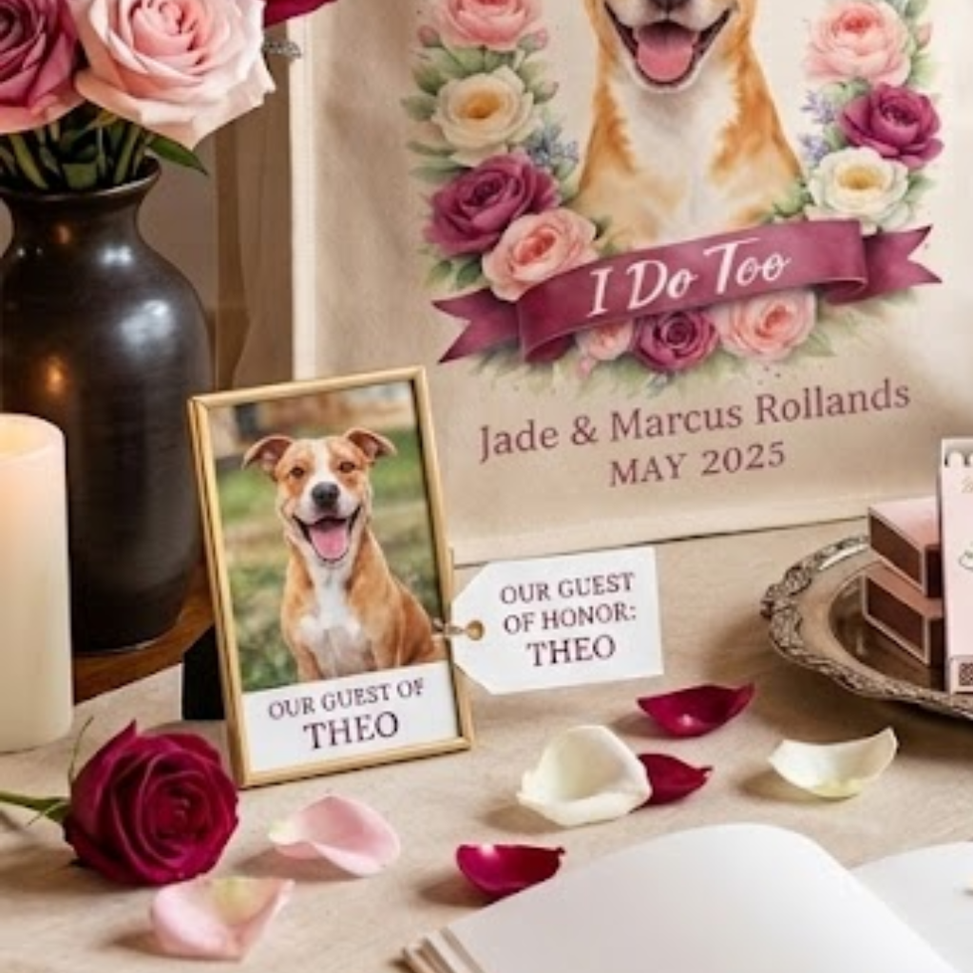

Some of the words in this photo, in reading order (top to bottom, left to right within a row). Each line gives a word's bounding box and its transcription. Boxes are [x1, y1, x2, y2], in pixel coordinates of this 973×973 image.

[586, 265, 614, 317] I
[626, 258, 700, 302] Do
[703, 236, 793, 295] Too
[478, 421, 560, 464] Jade
[570, 415, 600, 445] &
[609, 403, 744, 443] Marcus
[755, 377, 912, 423] Rollands
[609, 452, 688, 489] MAY
[700, 439, 786, 477] 2025
[500, 582, 551, 605] OUR
[558, 572, 635, 598] GUEST
[503, 613, 534, 635] OF
[541, 603, 637, 630] HONOR:
[526, 634, 617, 668] THEO
[268, 696, 316, 720] OUR
[321, 684, 392, 713] GUEST
[397, 677, 425, 698] OF
[303, 710, 400, 751] THEO
